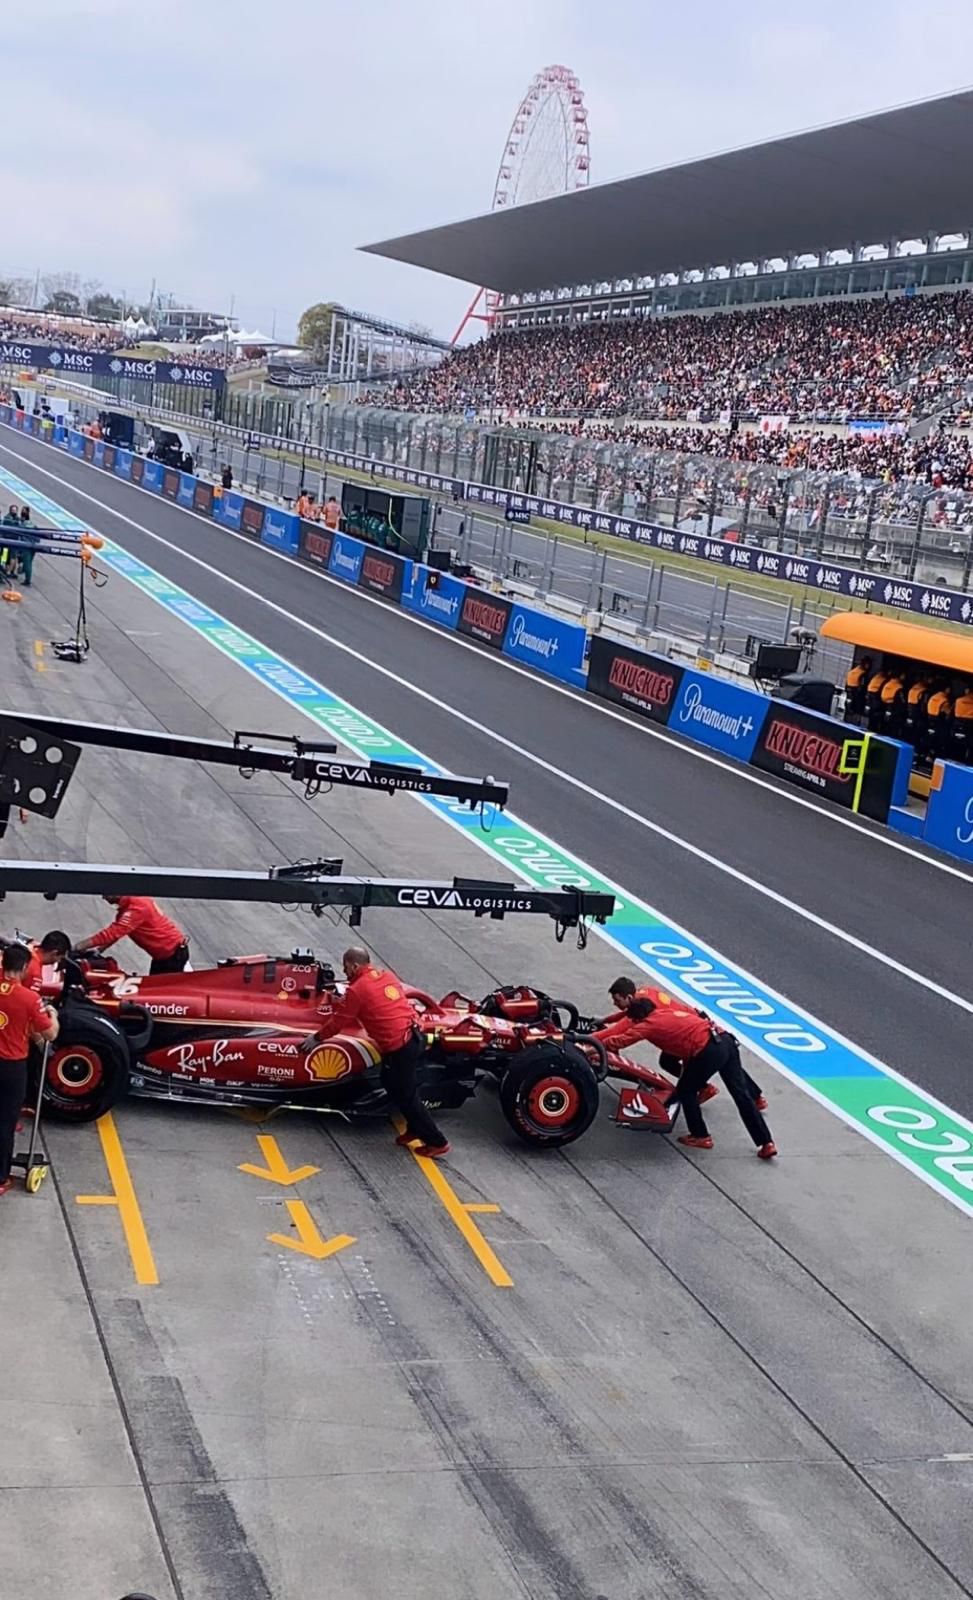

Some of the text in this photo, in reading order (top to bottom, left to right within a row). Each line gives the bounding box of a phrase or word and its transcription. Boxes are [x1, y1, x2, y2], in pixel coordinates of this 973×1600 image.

[2, 345, 31, 359] MSC
[64, 353, 93, 367] MSC
[124, 361, 154, 374] MSC
[184, 369, 213, 382] MSC
[711, 544, 724, 557] MSC
[736, 550, 751, 563] MSC
[764, 556, 779, 570] MSC
[793, 563, 809, 577] MSC
[824, 570, 841, 585] MSC
[893, 585, 912, 601] MSC
[931, 594, 951, 611] MSC
[510, 614, 559, 658] Paramount+
[609, 657, 674, 705] KNUCKLES
[679, 683, 753, 740] Paramount+
[765, 720, 852, 782] KNUCKL
[374, 776, 432, 791] LOGISTICS
[466, 898, 532, 909] LOGISTICS
[639, 942, 827, 1052] aramco
[145, 1002, 189, 1015] tander
[167, 1040, 244, 1072] Ray-Ban
[258, 1065, 295, 1076] PERONI
